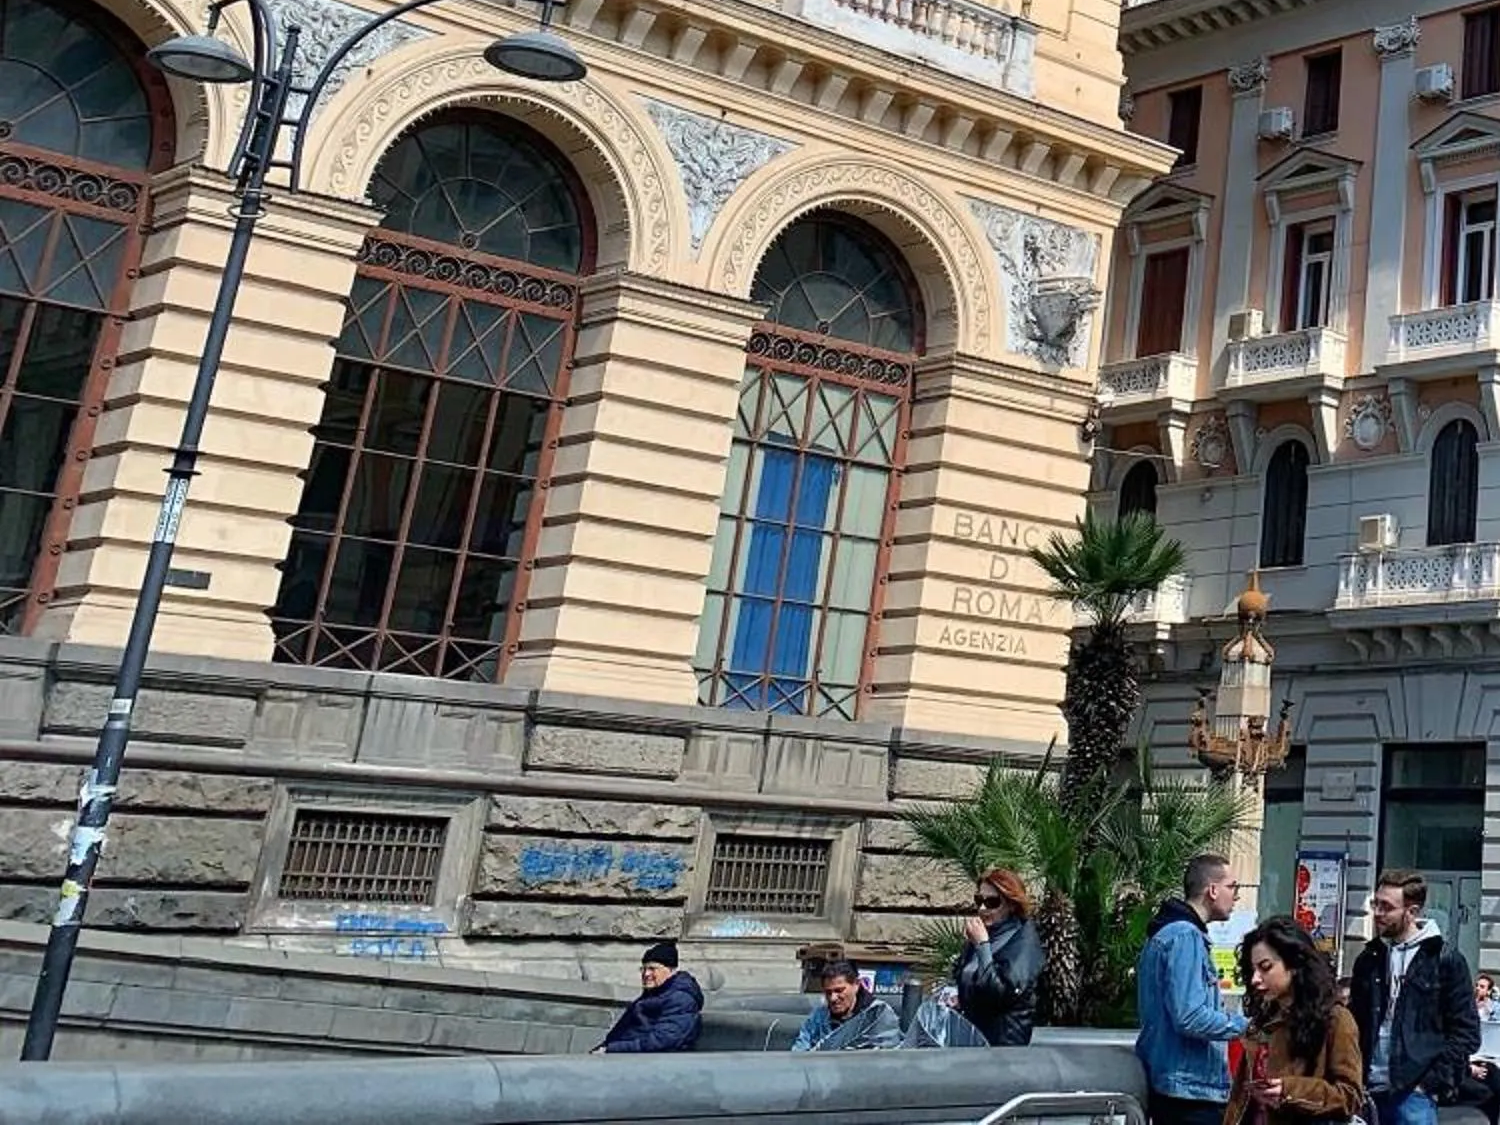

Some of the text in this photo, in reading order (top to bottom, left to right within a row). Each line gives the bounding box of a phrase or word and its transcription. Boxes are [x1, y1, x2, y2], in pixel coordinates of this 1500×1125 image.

[954, 513, 1040, 548] BANC
[952, 586, 1043, 623] ROMA
[938, 625, 1027, 654] AGENZIA
